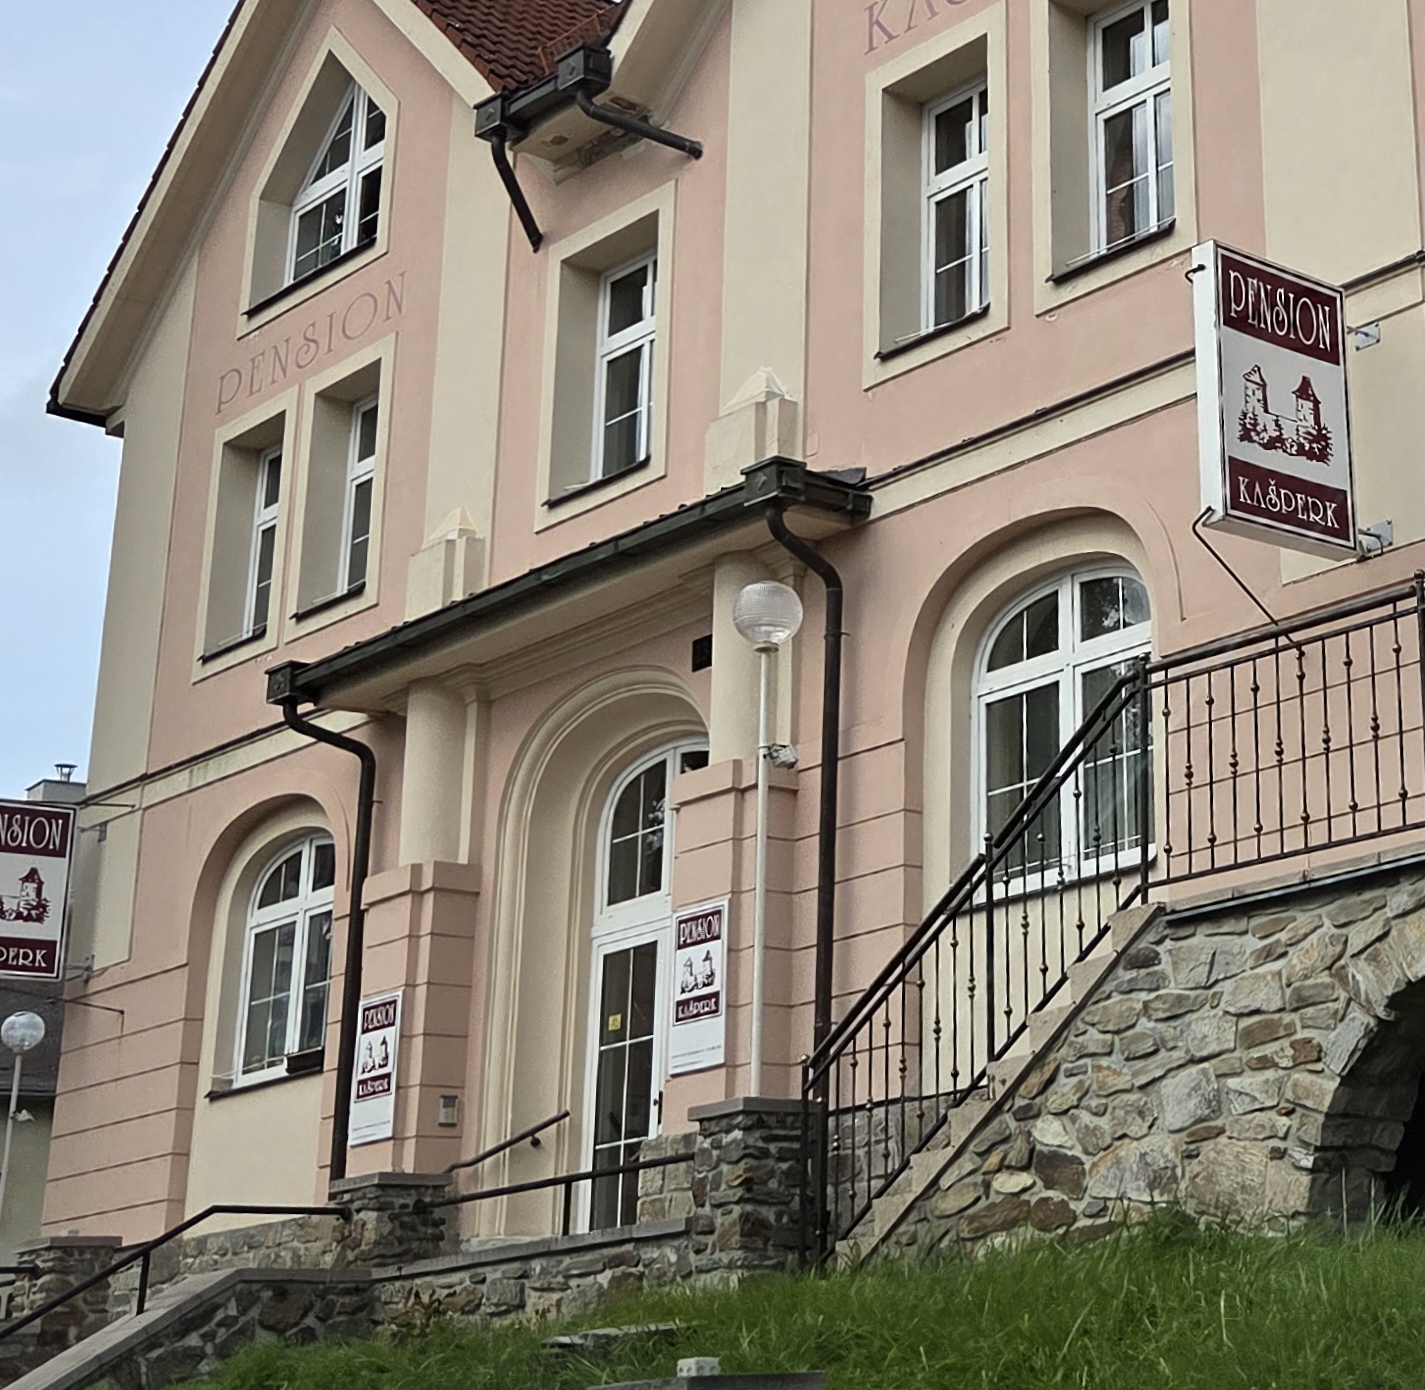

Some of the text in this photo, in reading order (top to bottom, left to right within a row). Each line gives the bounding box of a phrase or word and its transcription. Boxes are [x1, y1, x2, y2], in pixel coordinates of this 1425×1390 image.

[215, 270, 407, 415] PENSION
[1229, 270, 1330, 352] PENSION
[1238, 475, 1340, 529] KAŠPERK
[680, 915, 720, 945] PENSION
